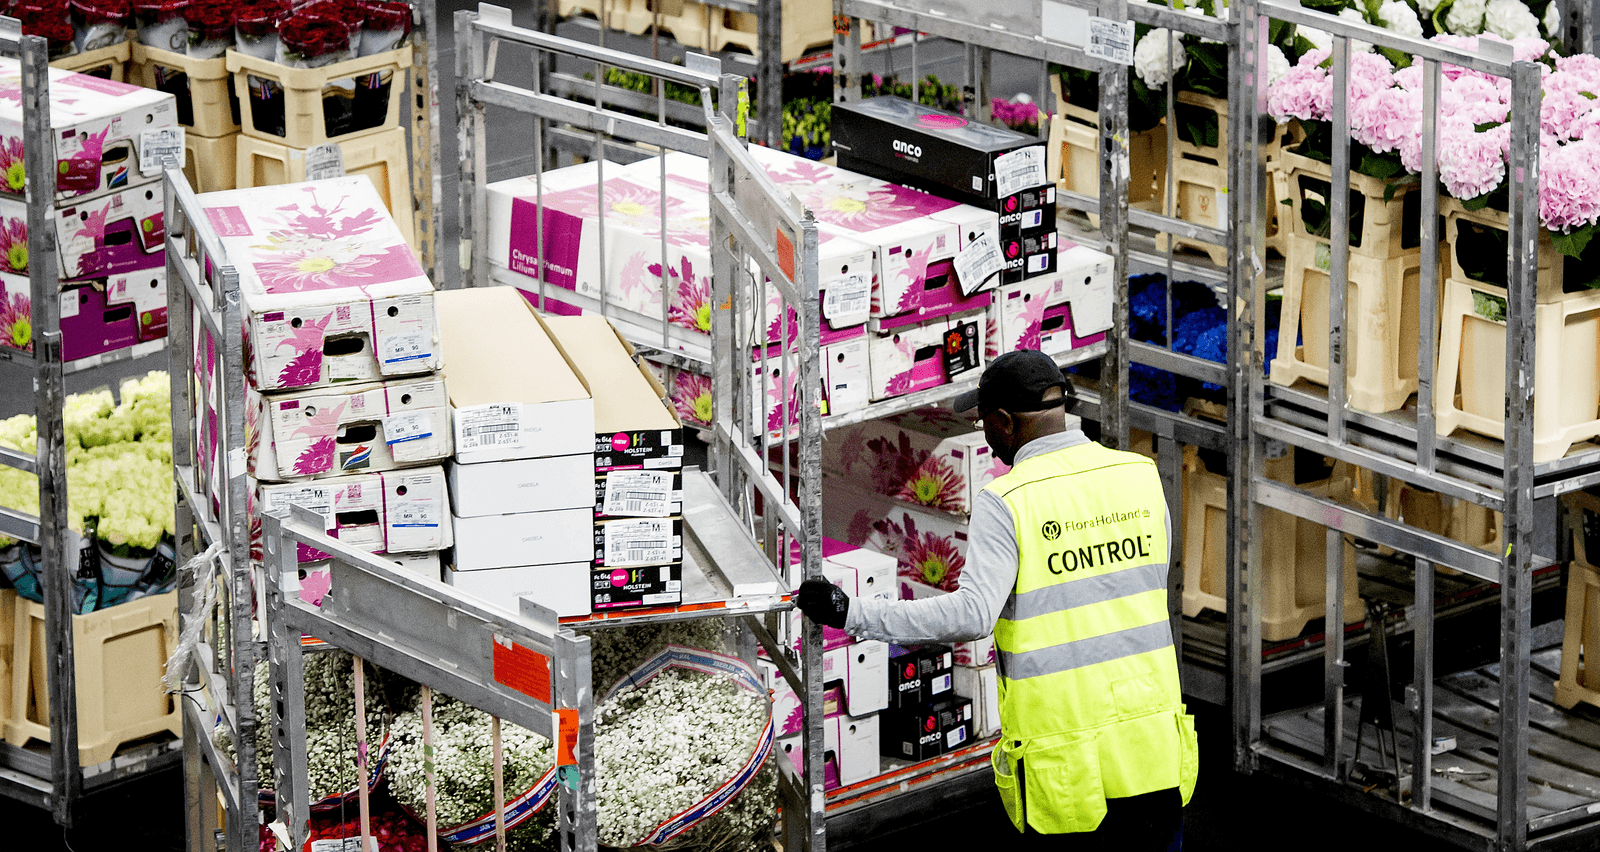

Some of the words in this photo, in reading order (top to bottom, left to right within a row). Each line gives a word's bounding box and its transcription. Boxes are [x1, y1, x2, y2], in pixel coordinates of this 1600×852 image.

[892, 139, 922, 158] anco
[999, 212, 1022, 225] anco
[512, 260, 536, 275] Lilium
[314, 490, 323, 498] M
[1065, 508, 1141, 532] FloraHolland
[622, 582, 652, 591] HOLSTEIN
[898, 678, 921, 692] anco
[919, 731, 942, 745] anco
